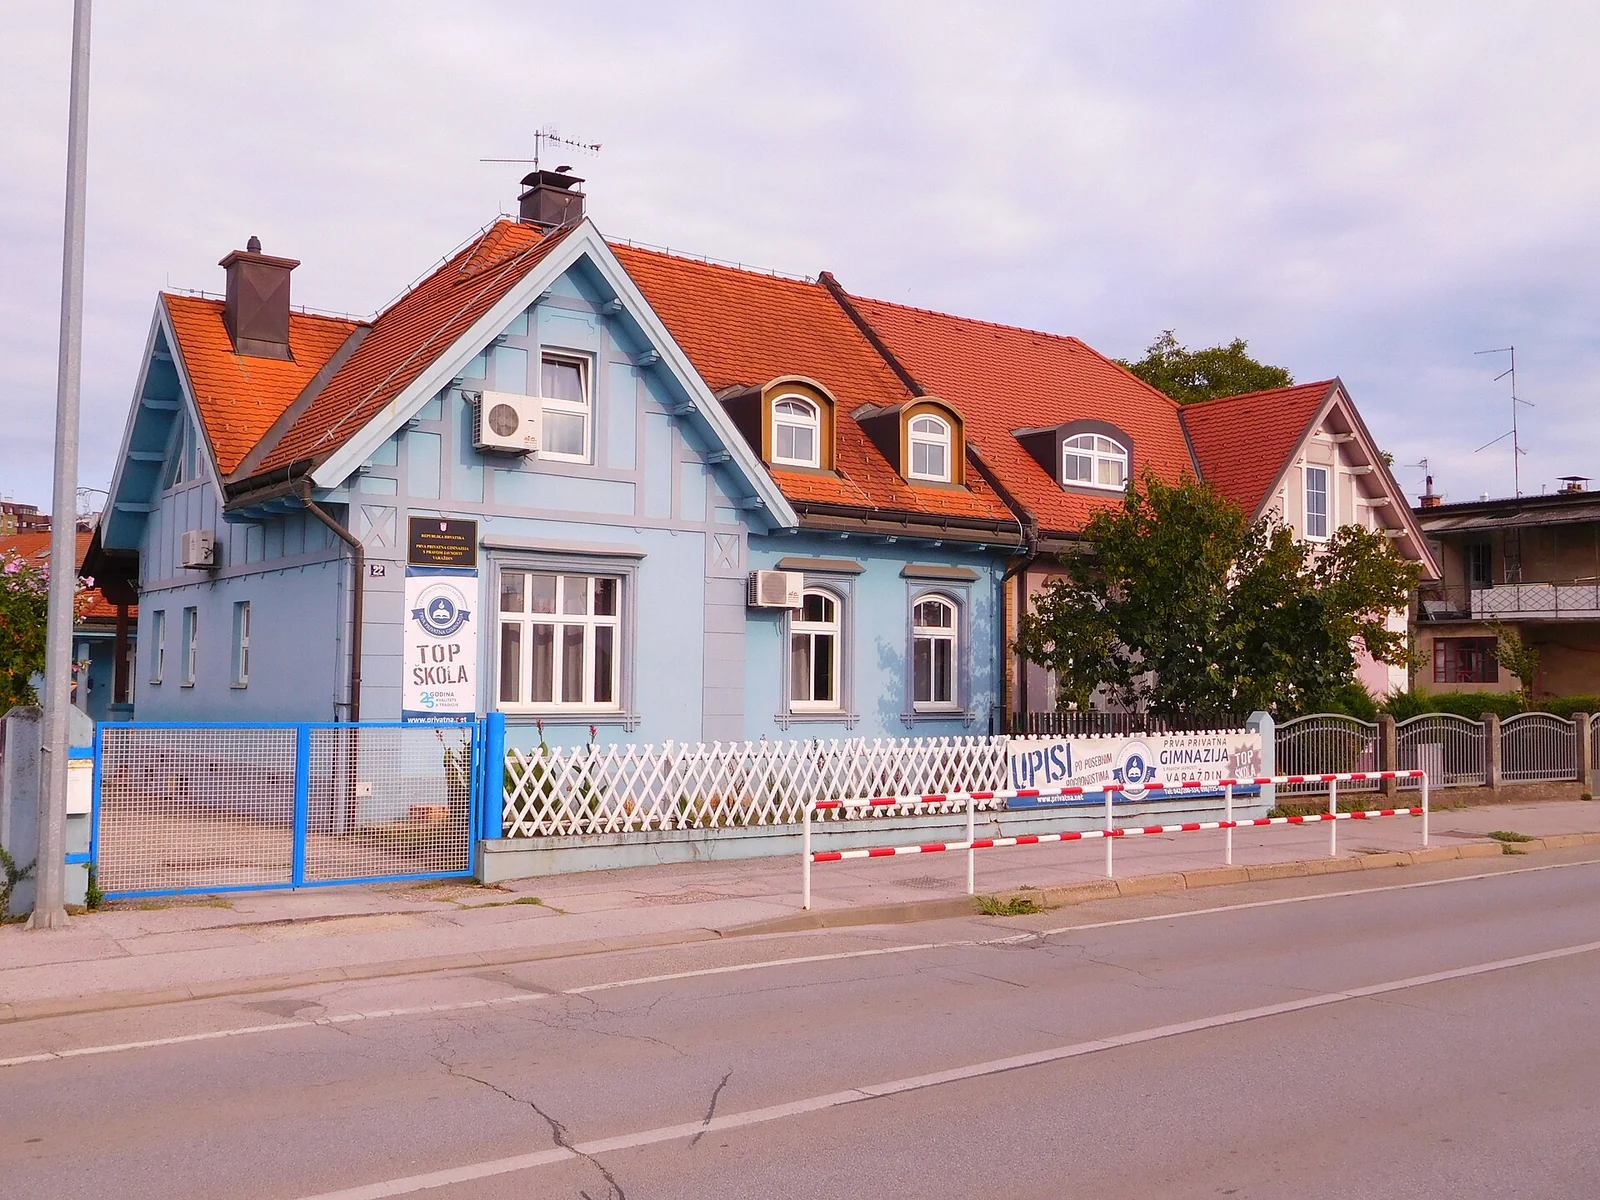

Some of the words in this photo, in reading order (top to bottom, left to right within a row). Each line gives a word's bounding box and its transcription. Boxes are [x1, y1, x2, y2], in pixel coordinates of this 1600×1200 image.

[373, 565, 384, 576] 22
[416, 644, 461, 663] TOP
[413, 664, 468, 685] ŠKOLA
[420, 691, 435, 709] 25
[1163, 739, 1185, 748] PRVA
[1187, 738, 1227, 747] PRIVATNA
[1075, 760, 1083, 772] PO
[1084, 753, 1112, 769] POSEBNIM
[1160, 748, 1229, 765] GIMNAZIJA
[1234, 750, 1254, 767] TOP
[1011, 742, 1072, 789] UPISI
[1166, 769, 1222, 782] VARAŽDIN
[1037, 794, 1084, 803] www.privatna.net
